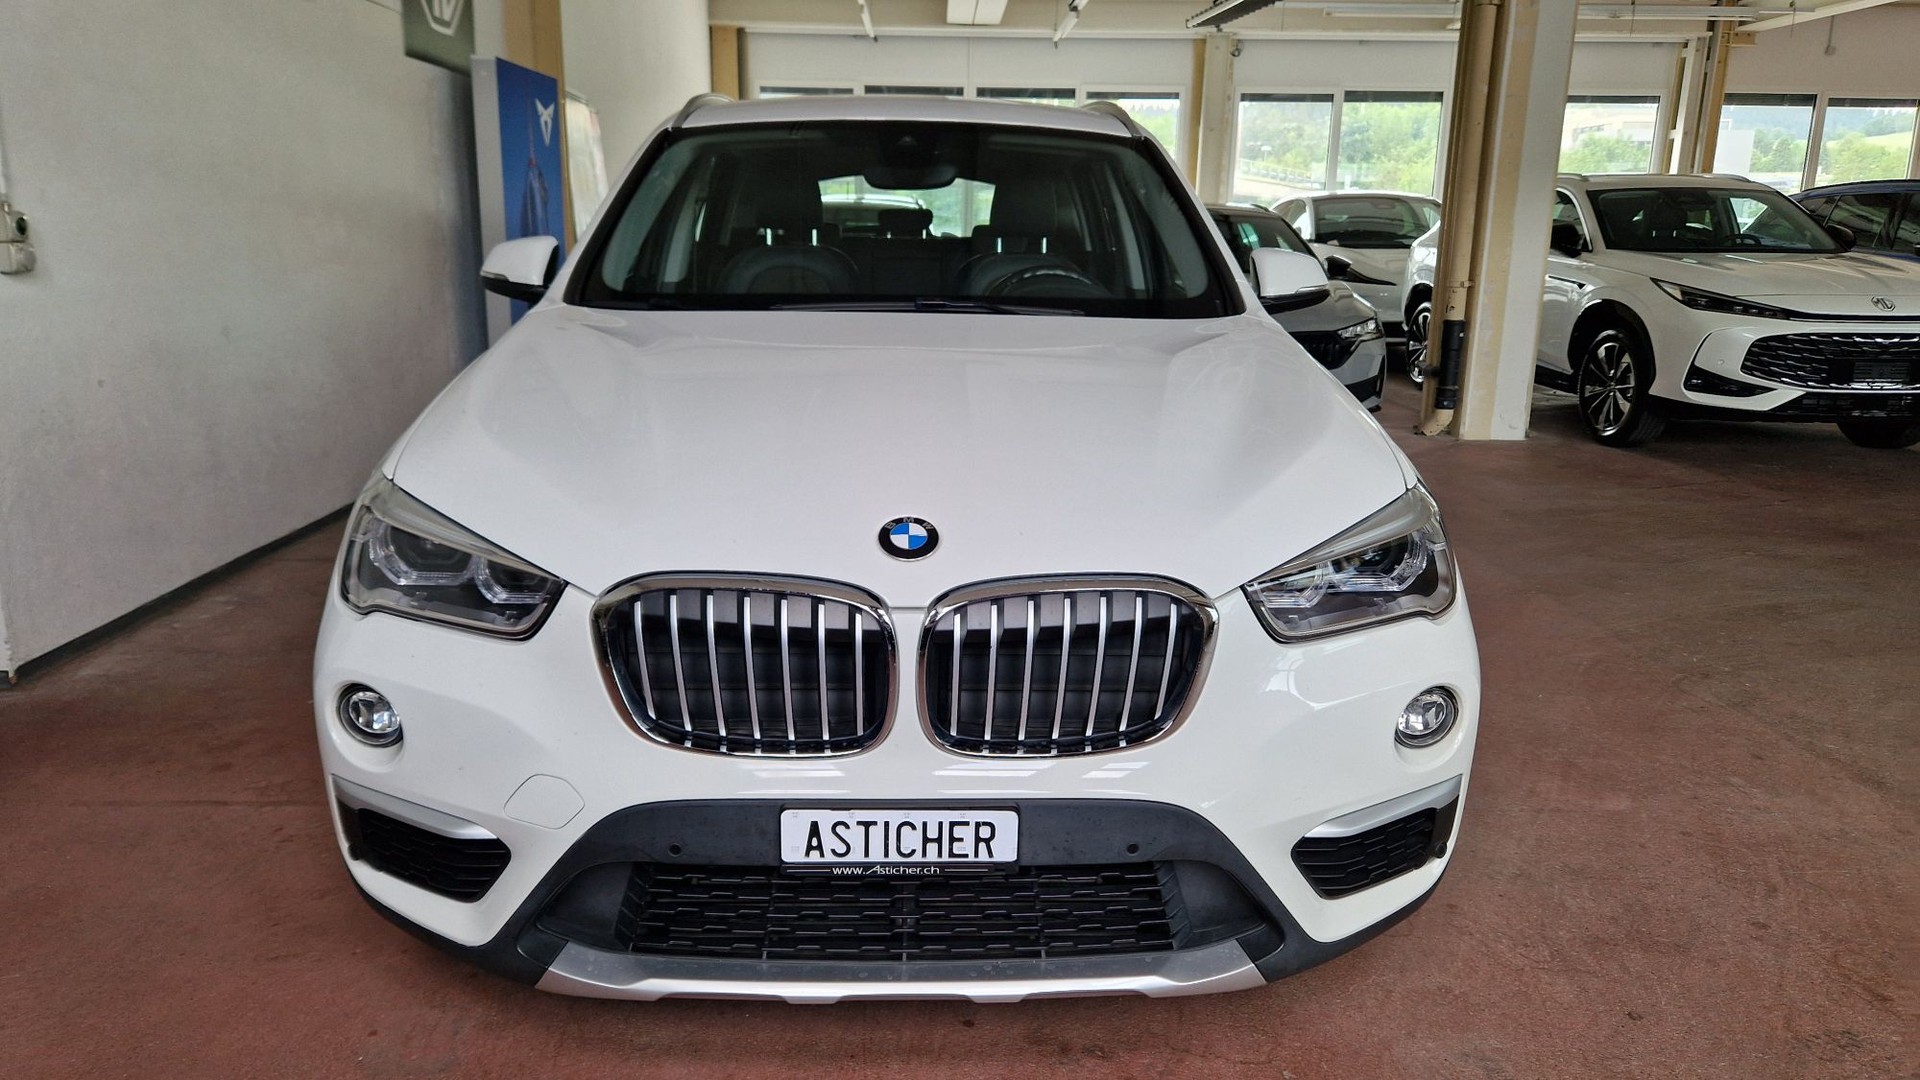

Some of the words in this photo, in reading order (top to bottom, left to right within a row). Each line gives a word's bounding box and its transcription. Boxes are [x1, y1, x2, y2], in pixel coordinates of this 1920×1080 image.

[884, 517, 934, 530] BMW
[804, 820, 996, 859] ASTICHER
[832, 865, 940, 875] www.Asticher.ch
